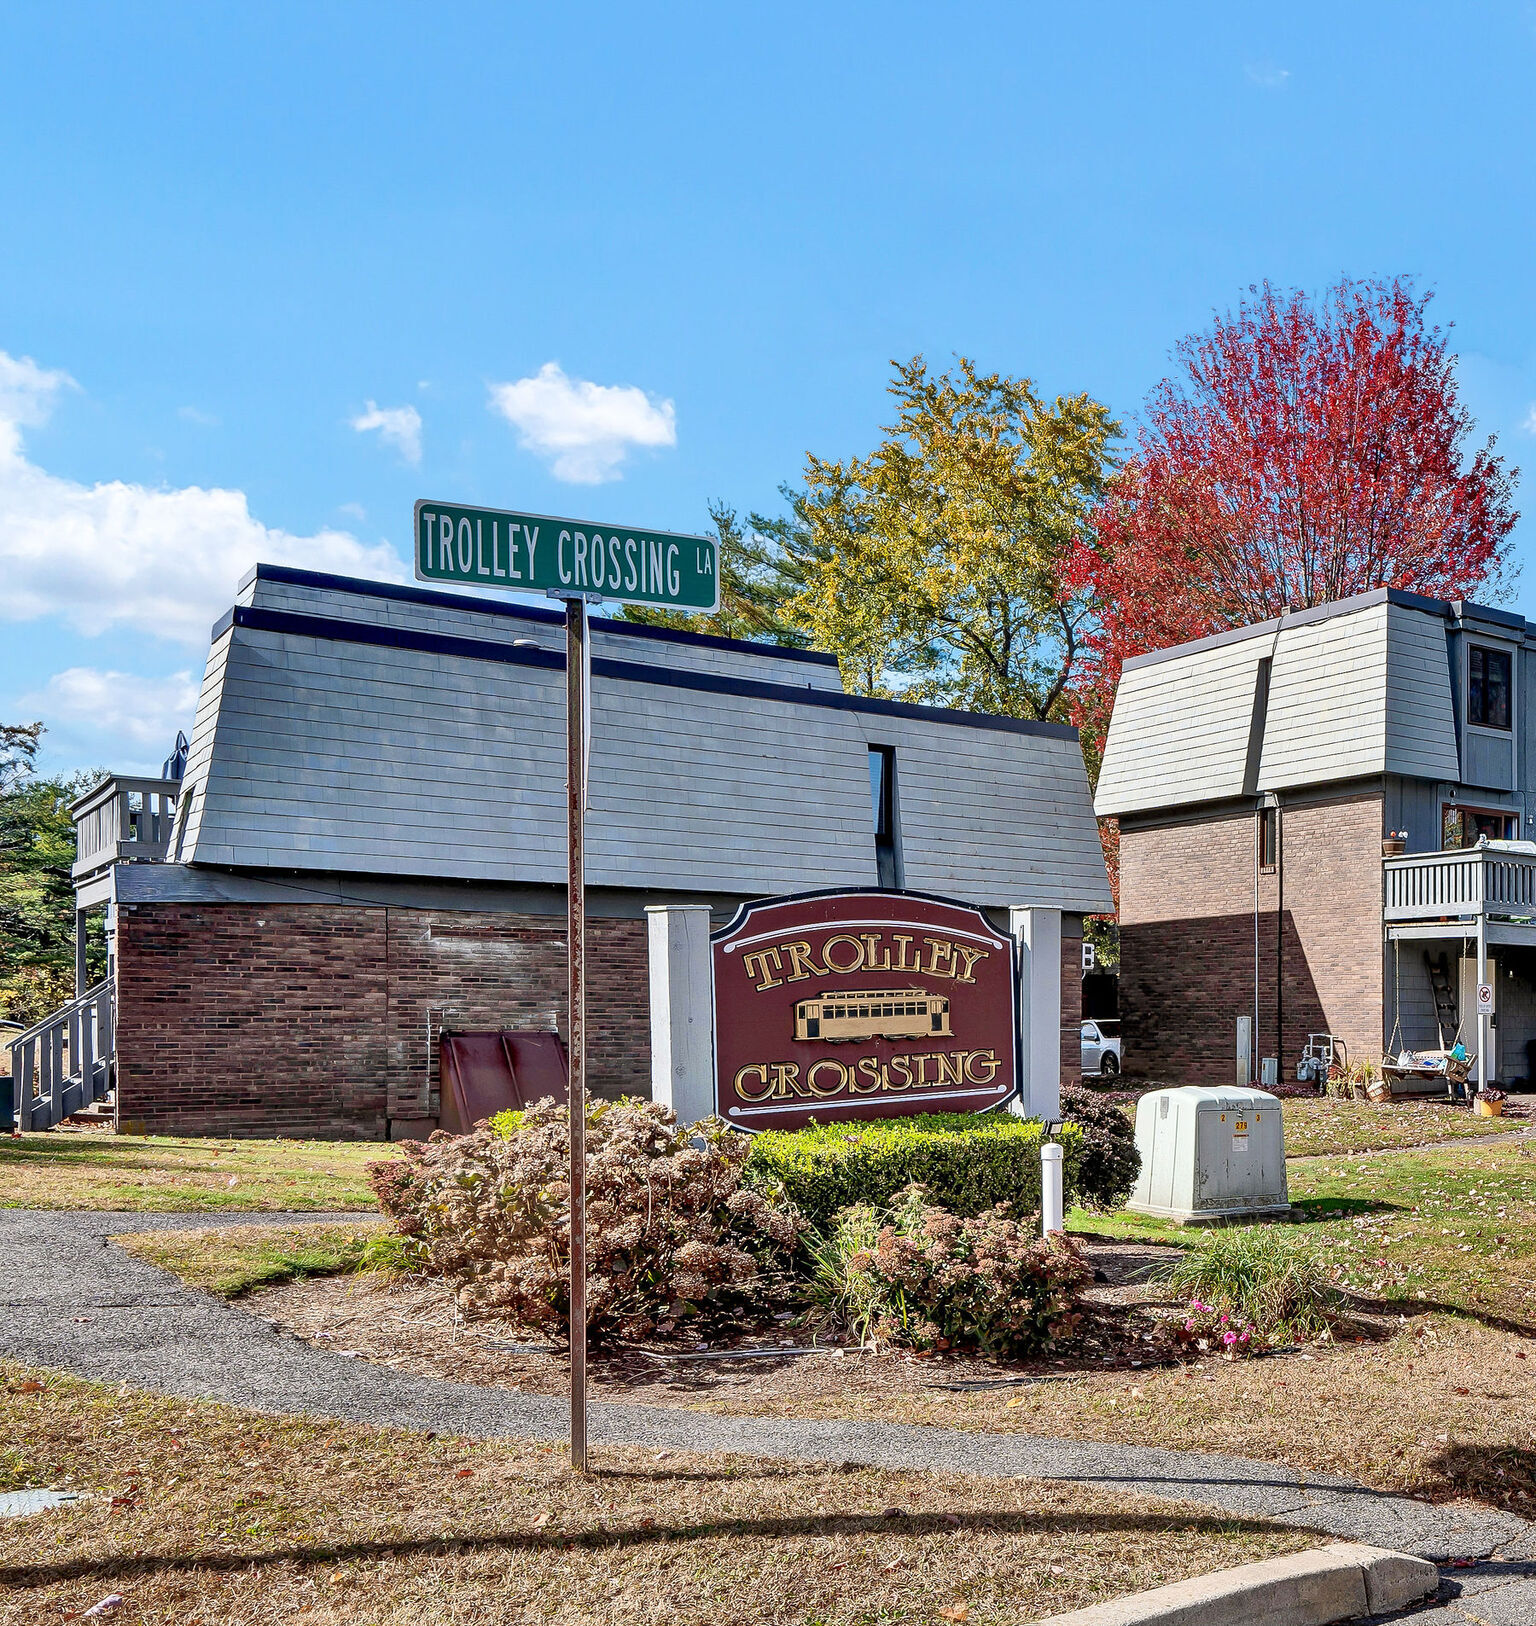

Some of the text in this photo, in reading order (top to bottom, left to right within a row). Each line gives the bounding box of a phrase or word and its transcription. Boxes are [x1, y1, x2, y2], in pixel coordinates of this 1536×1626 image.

[423, 513, 712, 597] TROLLEY CROSSING LA
[743, 933, 990, 992] TROLLEY
[733, 1049, 1002, 1102] CROSSING
